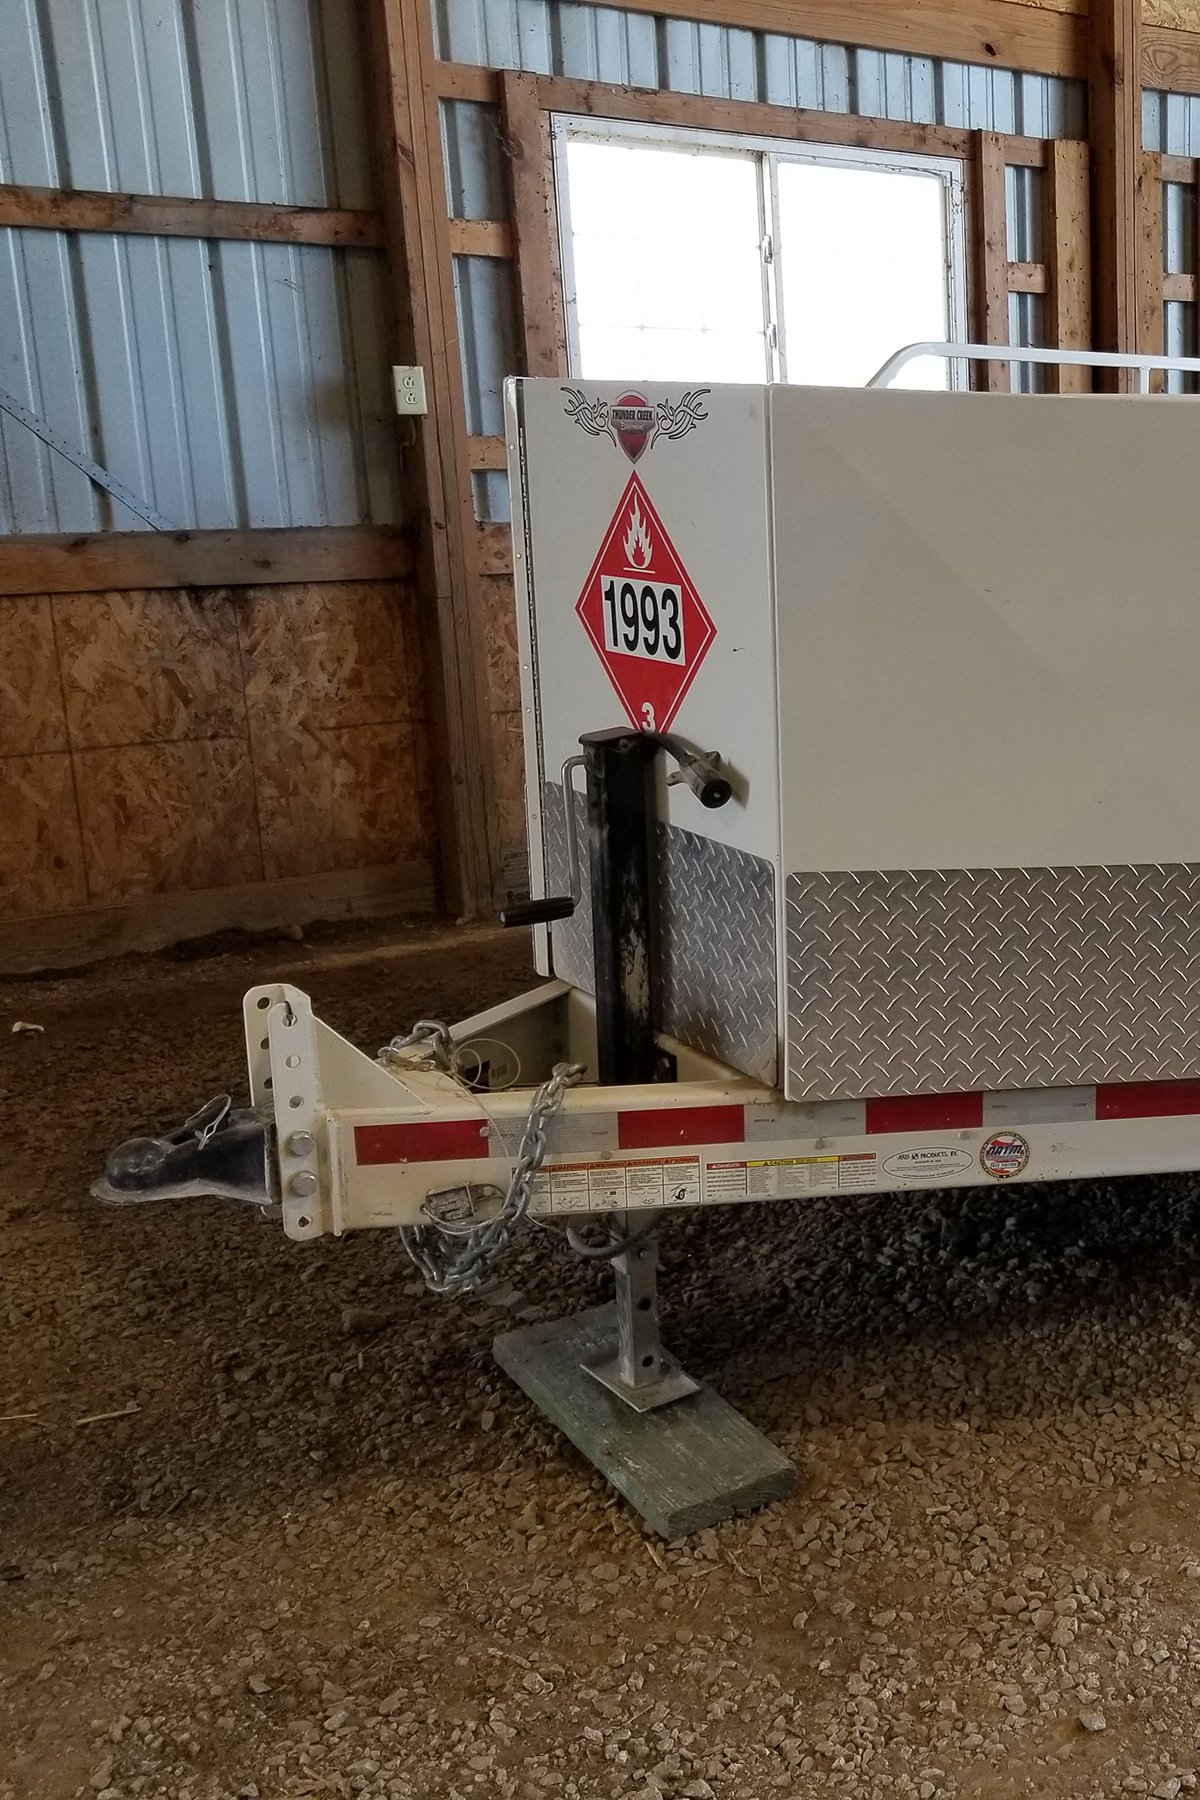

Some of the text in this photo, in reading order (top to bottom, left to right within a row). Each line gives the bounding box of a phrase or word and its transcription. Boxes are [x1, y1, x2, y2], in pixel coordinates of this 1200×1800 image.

[612, 409, 653, 421] THUNDER CREEK
[604, 580, 682, 660] 1993
[641, 702, 656, 733] 3
